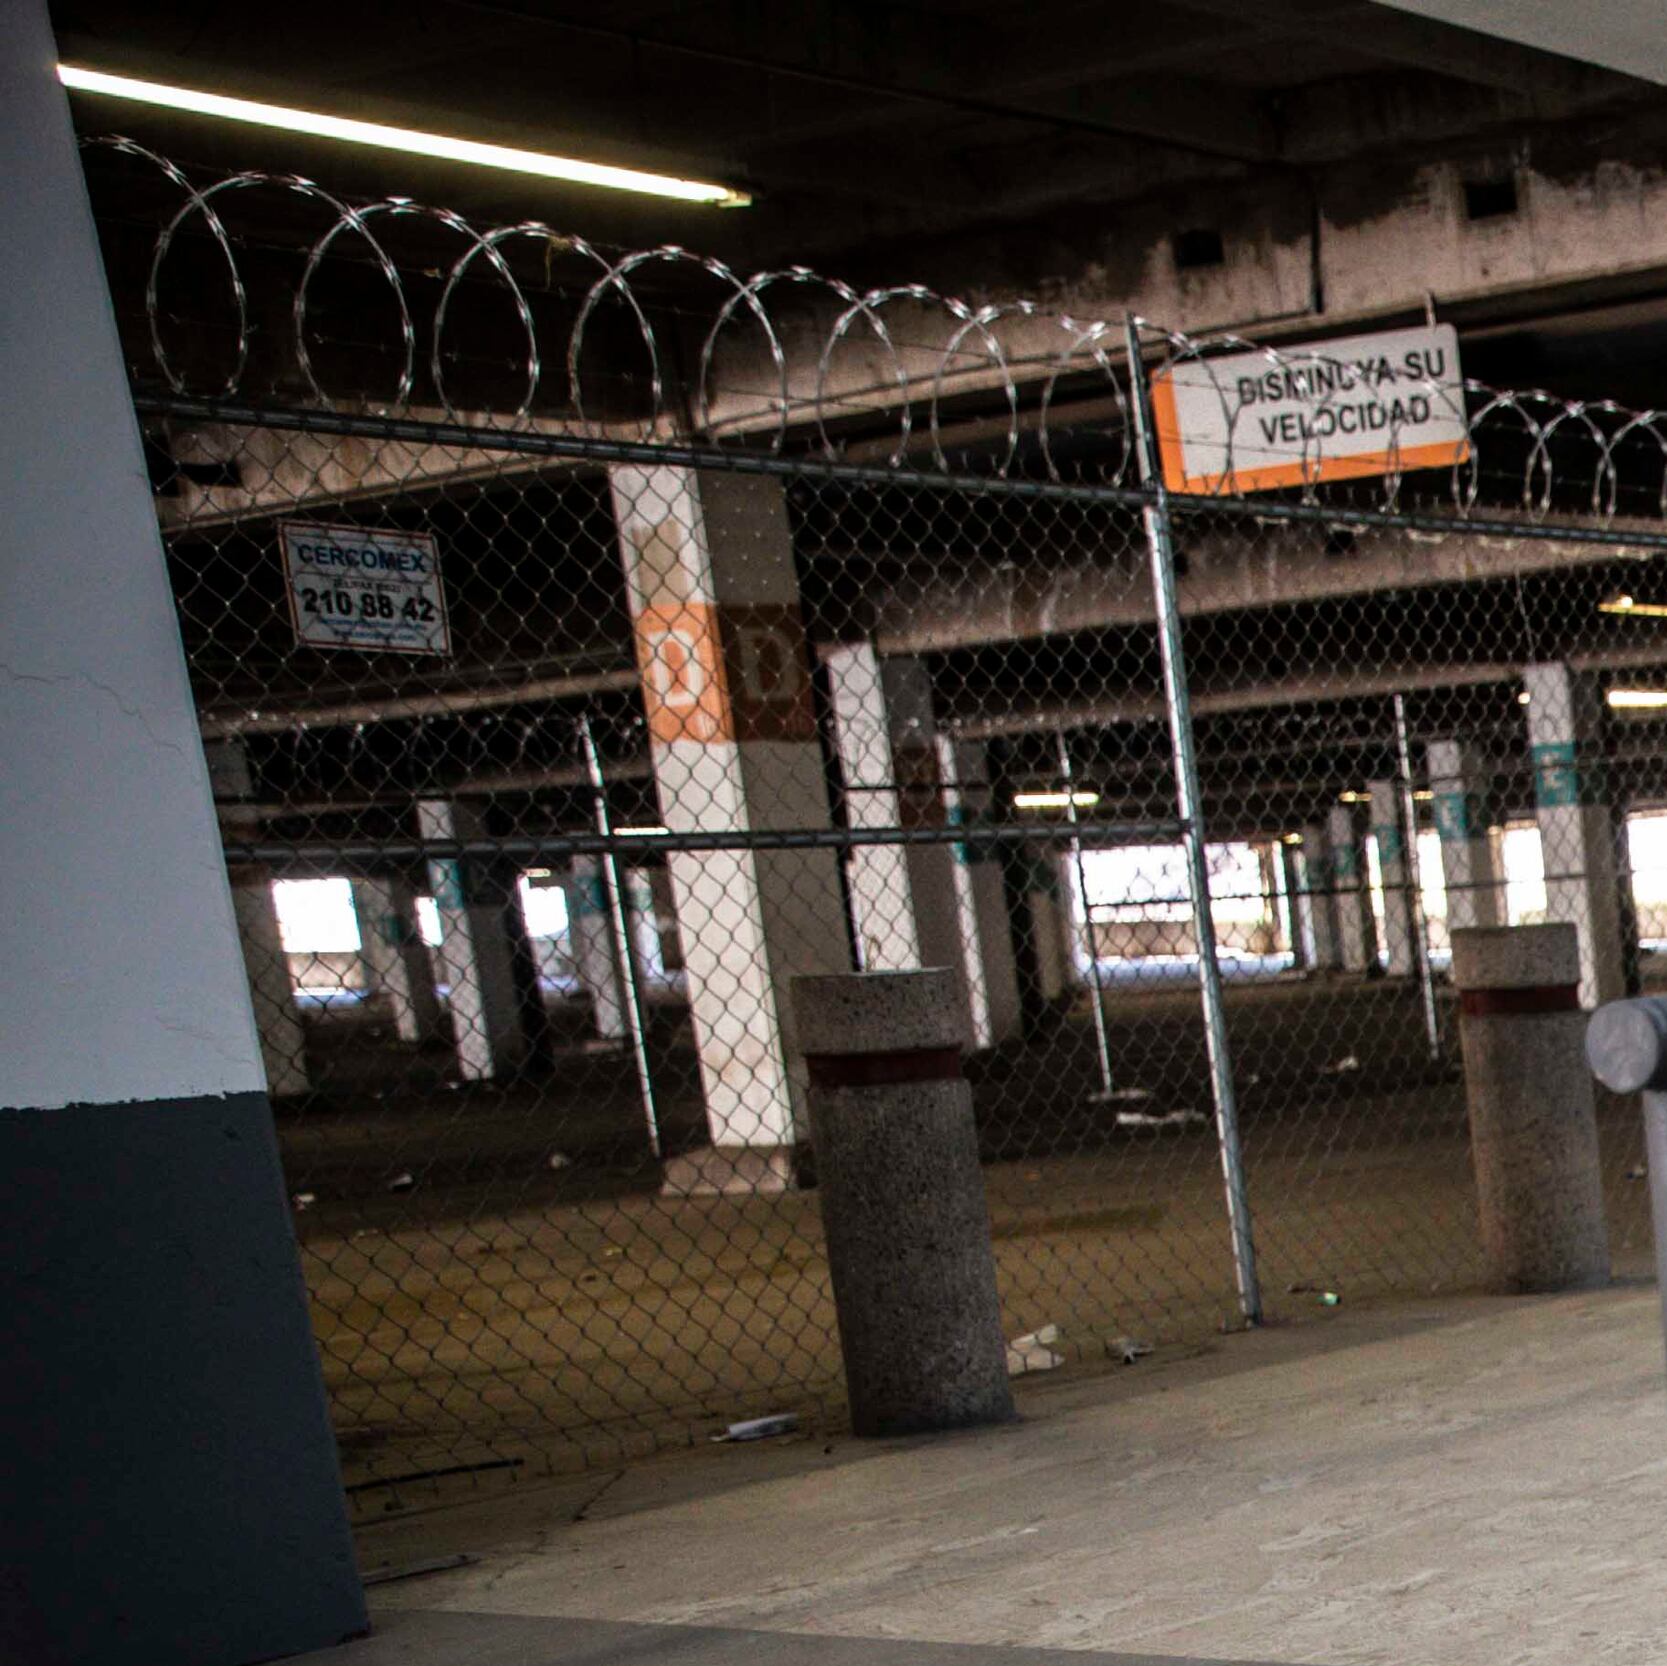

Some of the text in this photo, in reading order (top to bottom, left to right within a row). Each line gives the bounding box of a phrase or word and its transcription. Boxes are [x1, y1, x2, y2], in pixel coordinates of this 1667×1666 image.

[1237, 348, 1445, 405] DISMINUYA SU
[1260, 395, 1430, 444] VELOCIDAD
[298, 544, 426, 573] CERCOMEX
[301, 587, 435, 622] 210 88 42
